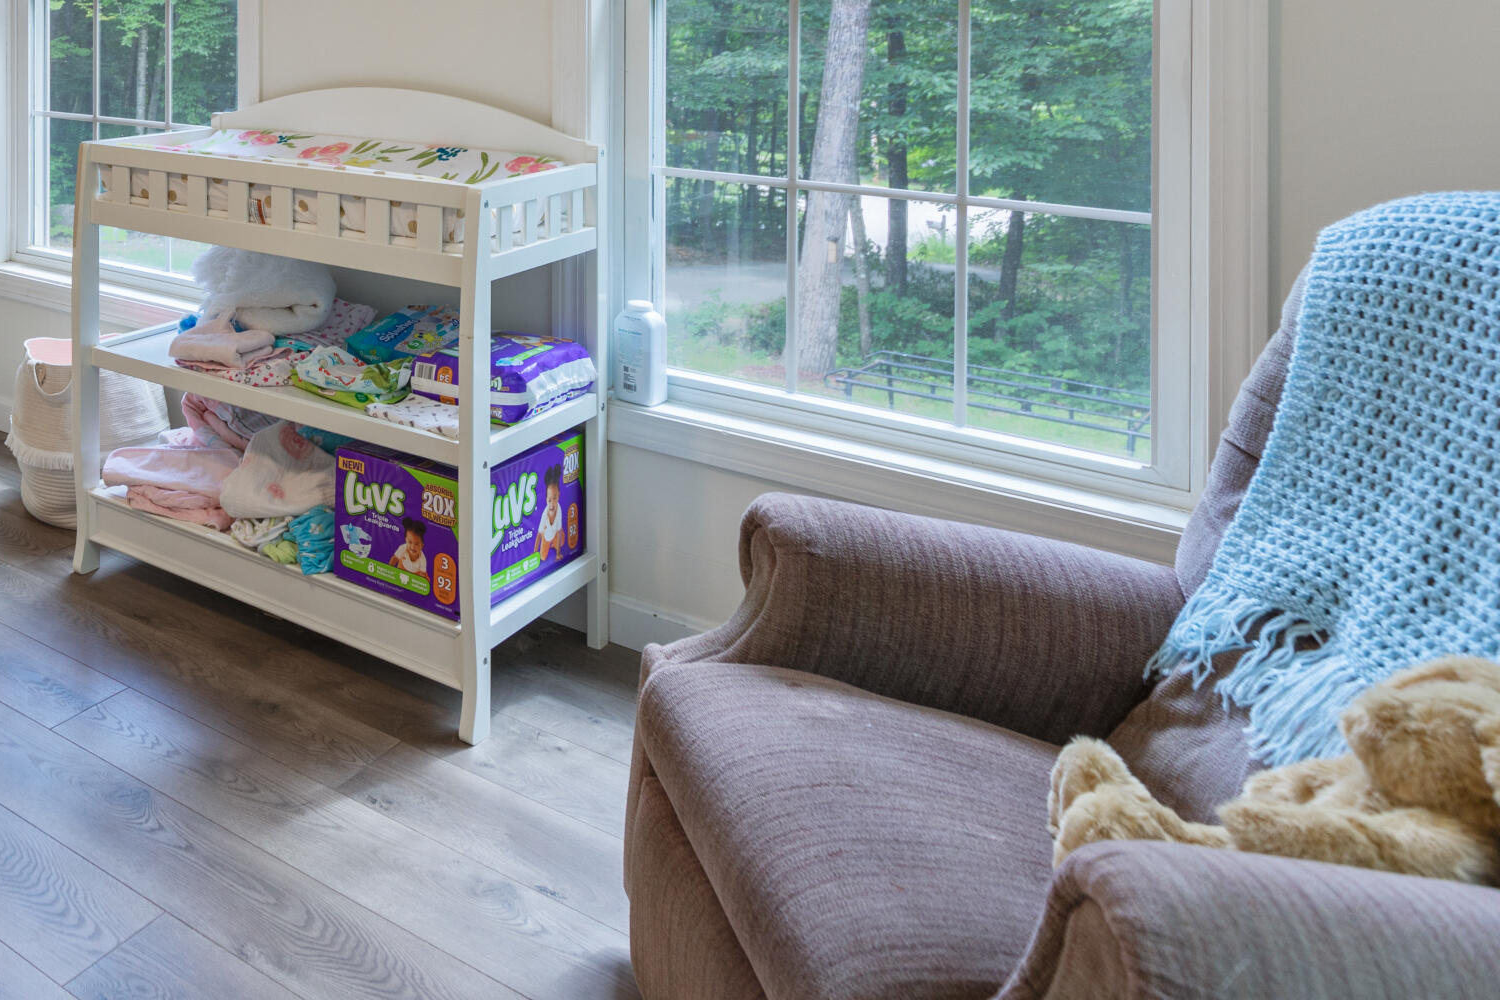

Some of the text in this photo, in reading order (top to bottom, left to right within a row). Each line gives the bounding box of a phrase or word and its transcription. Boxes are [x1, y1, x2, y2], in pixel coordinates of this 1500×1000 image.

[439, 373, 450, 384] 34
[342, 459, 363, 472] NEW!
[563, 451, 580, 475] 20X
[345, 471, 406, 516] Luvs
[423, 491, 455, 519] 20X
[371, 512, 389, 523] Triple
[570, 506, 575, 518] 3
[432, 513, 456, 526] WEIGHT
[508, 527, 524, 540] Triple
[569, 523, 577, 536] 92
[440, 557, 449, 570] 3
[437, 576, 452, 591] 92
